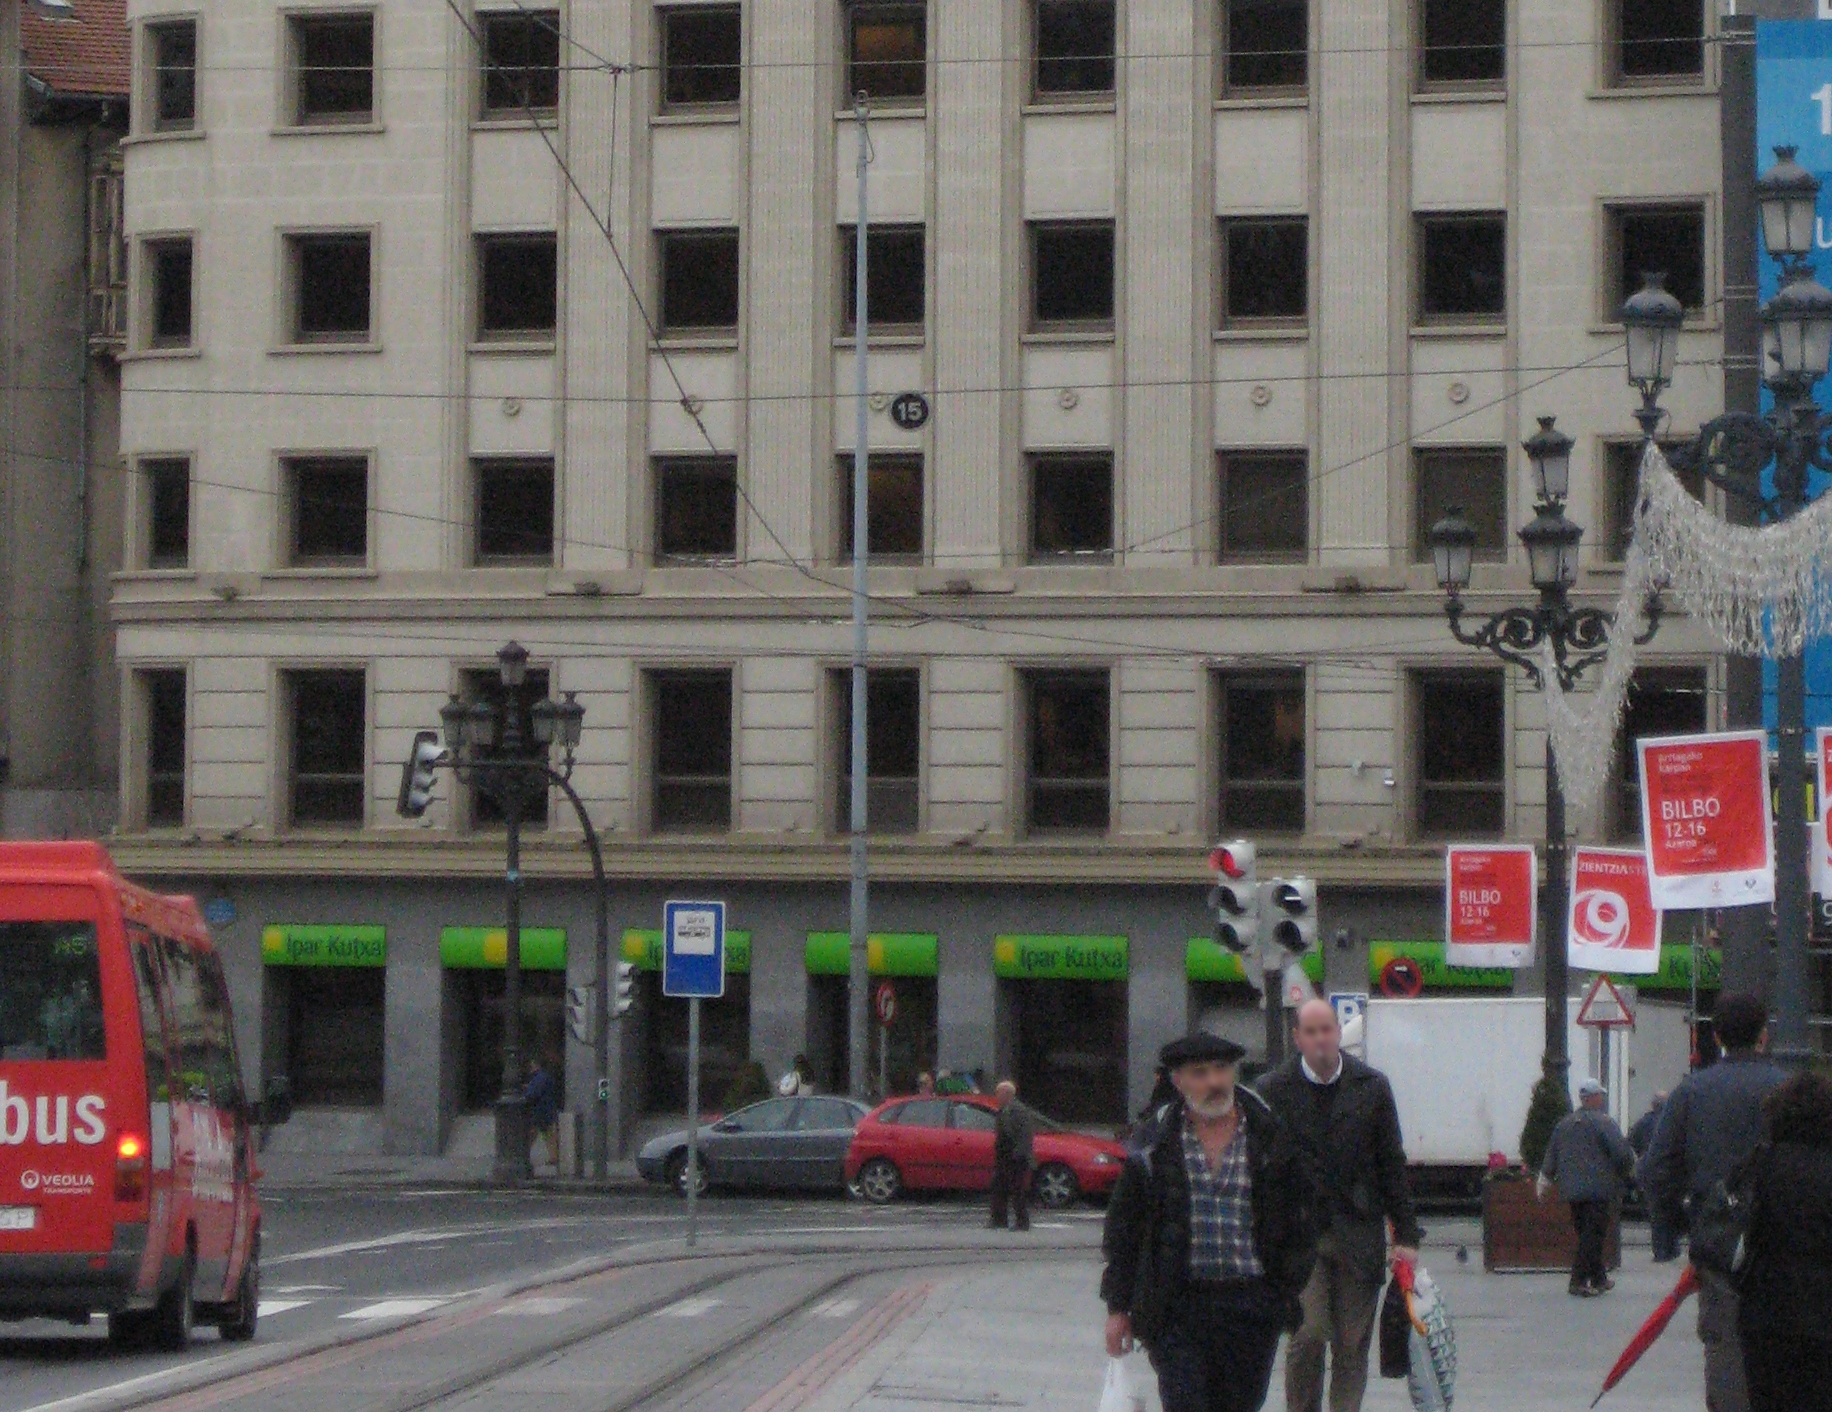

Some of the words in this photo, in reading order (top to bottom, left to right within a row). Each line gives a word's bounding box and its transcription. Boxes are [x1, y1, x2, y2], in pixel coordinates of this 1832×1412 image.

[898, 402, 922, 422] 15
[1662, 797, 1720, 821] BILBO
[1665, 821, 1706, 838] 12-16
[1459, 889, 1501, 906] BILBO
[1461, 906, 1490, 919] 1216
[0, 1079, 106, 1145] bus
[41, 1175, 95, 1186] VEOLIA
